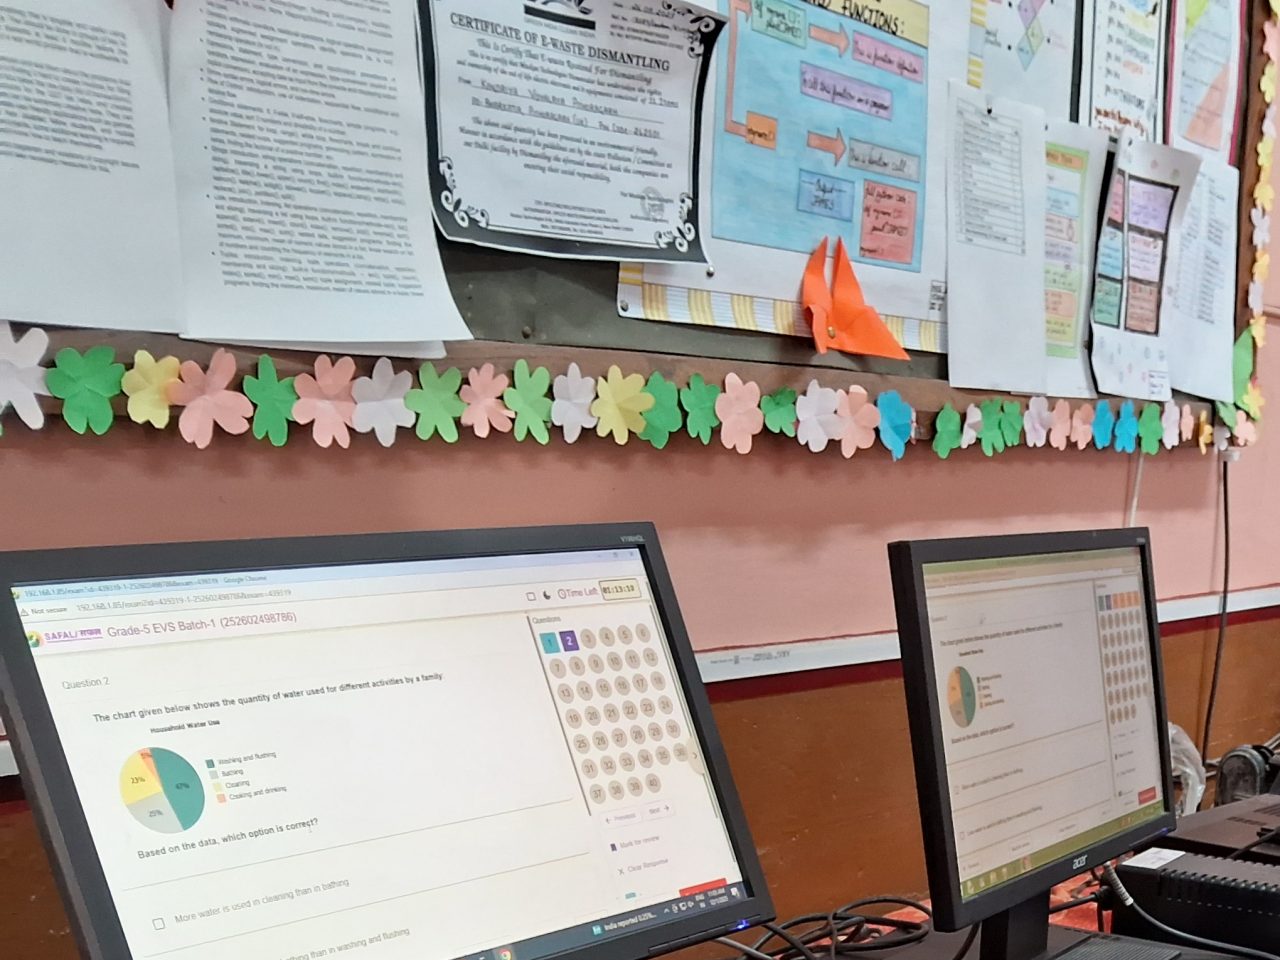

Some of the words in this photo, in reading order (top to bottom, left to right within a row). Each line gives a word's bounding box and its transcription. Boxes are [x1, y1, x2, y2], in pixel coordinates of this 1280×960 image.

[450, 12, 521, 40] CERTIFICATE
[524, 31, 538, 45] OF
[541, 35, 585, 56] E-WASTE
[588, 46, 670, 72] DISMANTLING
[566, 588, 582, 598] Time
[583, 587, 598, 596] Left
[46, 606, 68, 614] secure
[107, 624, 151, 639] Grade-5
[153, 622, 176, 634] EVS
[178, 618, 216, 632] Batch-1
[62, 677, 101, 690] Question
[103, 676, 110, 686] 2
[93, 713, 111, 723] The
[113, 710, 137, 721] chart
[138, 707, 163, 720] given
[165, 702, 190, 714] below
[193, 699, 220, 711] shows
[222, 697, 236, 707] the
[238, 693, 270, 707] quantity
[272, 691, 281, 700] of
[283, 689, 304, 699] water
[306, 687, 325, 698] used
[326, 685, 337, 693] for
[339, 681, 370, 692] different
[372, 677, 404, 688] activities
[405, 676, 414, 685] by
[150, 724, 185, 734] Household
[187, 721, 206, 729] Water
[208, 719, 220, 727] Use
[225, 780, 250, 790] Cleaning
[138, 847, 166, 859] Based
[168, 844, 181, 853] on
[182, 841, 196, 851] the
[198, 836, 219, 848] data,
[221, 831, 247, 843] which
[248, 826, 275, 840] option
[276, 824, 284, 833] is
[285, 818, 319, 832] correct?
[175, 912, 197, 923] More
[198, 907, 220, 920] water
[222, 904, 230, 914] is
[231, 899, 252, 912] used
[253, 897, 260, 906] in
[261, 891, 295, 905] cleaning
[295, 887, 312, 897] than
[313, 885, 321, 894] in
[322, 879, 350, 892] bathing
[310, 949, 327, 960] than
[328, 946, 336, 955] in
[337, 938, 367, 954] washing
[368, 936, 382, 947] and
[382, 927, 411, 942] flushing
